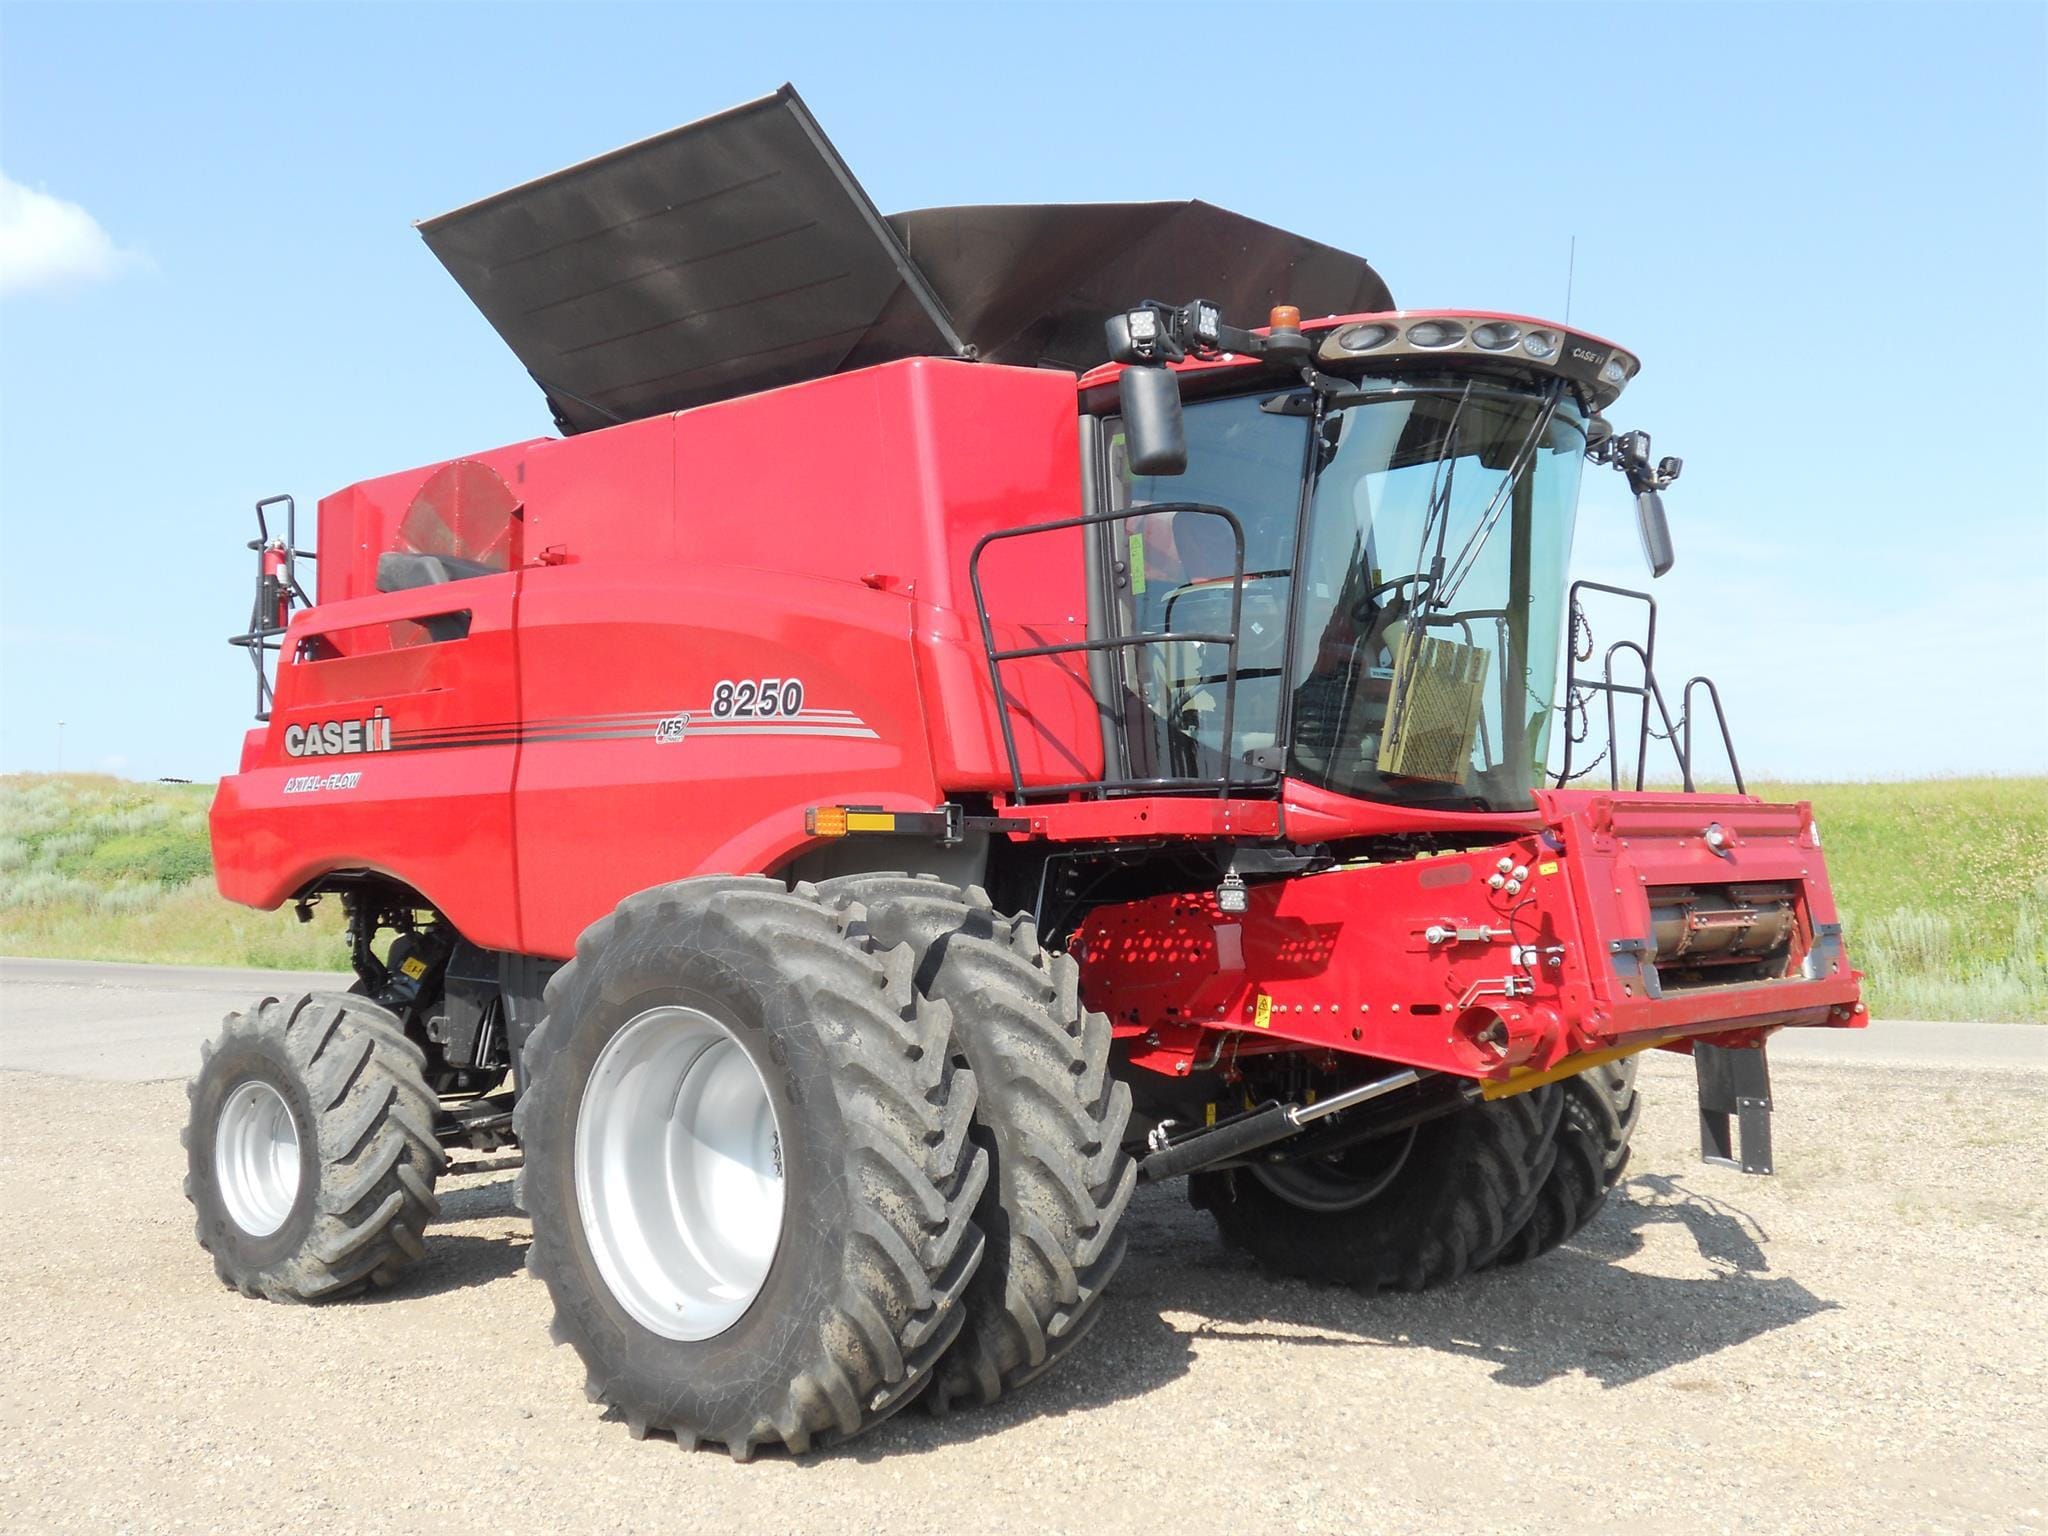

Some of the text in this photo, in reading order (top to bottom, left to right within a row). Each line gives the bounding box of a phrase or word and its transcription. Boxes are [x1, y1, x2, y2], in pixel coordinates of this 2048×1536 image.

[1573, 347, 1597, 362] CASE
[711, 678, 804, 719] 8250
[657, 719, 682, 735] AFS
[284, 720, 361, 757] CASE
[284, 772, 362, 794] AXIAL-FLOW
